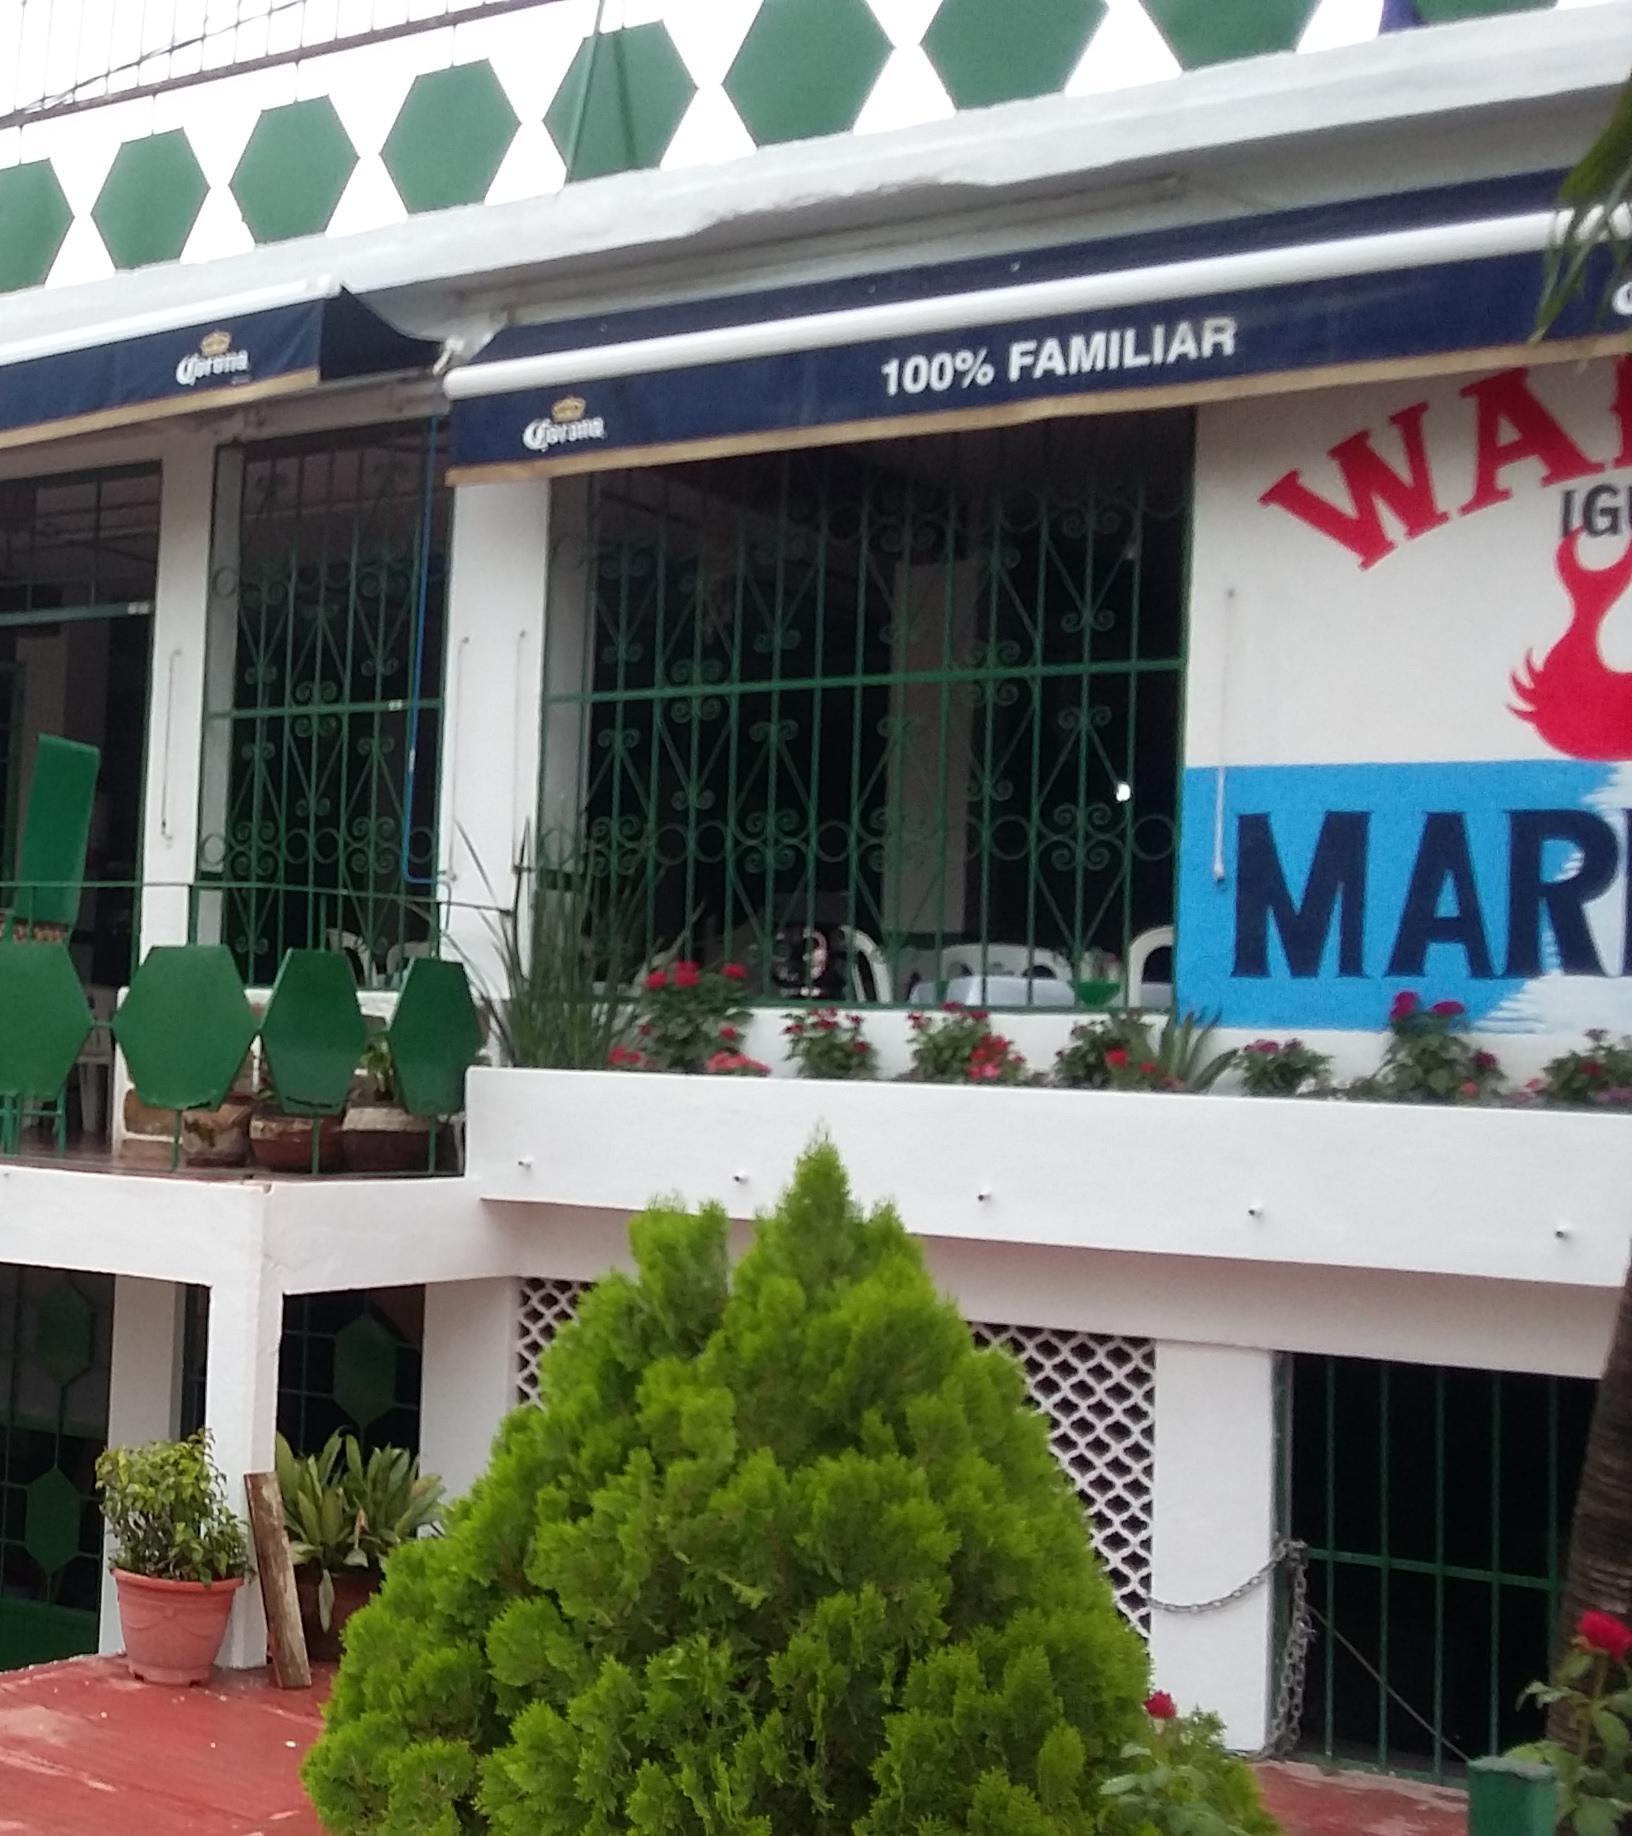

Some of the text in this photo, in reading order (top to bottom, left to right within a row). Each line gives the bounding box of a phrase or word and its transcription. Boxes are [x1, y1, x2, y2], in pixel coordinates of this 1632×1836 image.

[881, 316, 1238, 396] 100% FAMILIAR
[1560, 483, 1632, 538] IG
